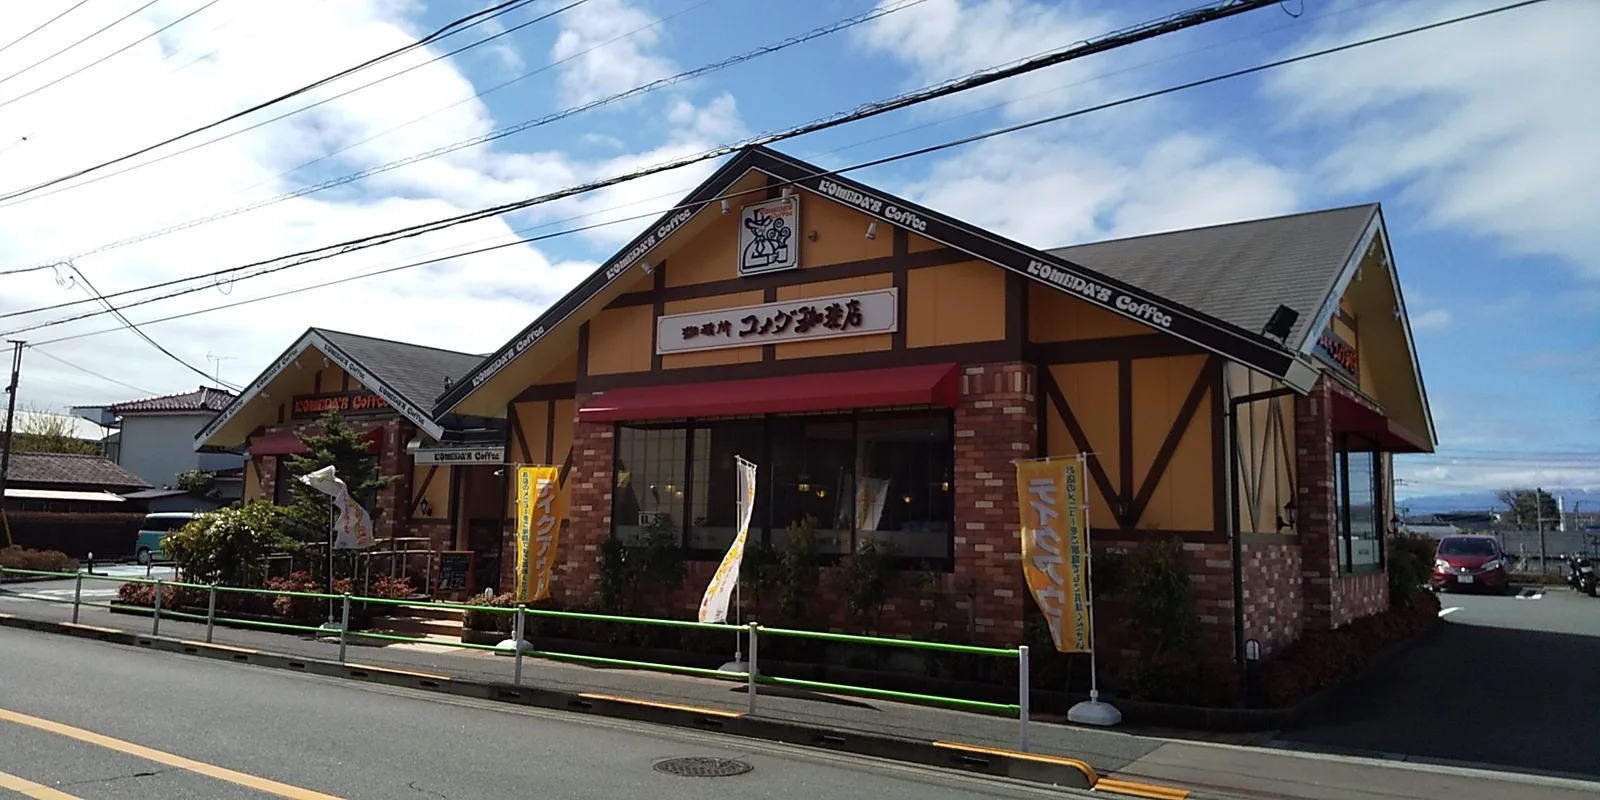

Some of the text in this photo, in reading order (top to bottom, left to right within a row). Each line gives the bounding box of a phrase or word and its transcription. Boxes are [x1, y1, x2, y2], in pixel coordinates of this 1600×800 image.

[818, 179, 927, 231] KOMEDA'S Coffee
[605, 208, 691, 280] KOMEDA'S Coffee
[738, 298, 864, 338] コメダ珈琲店
[1026, 259, 1173, 328] KOMEDA'S Coffee
[471, 325, 545, 387] KOMEDA'S Coffee
[434, 451, 501, 461] KOMEDA'S Coffee
